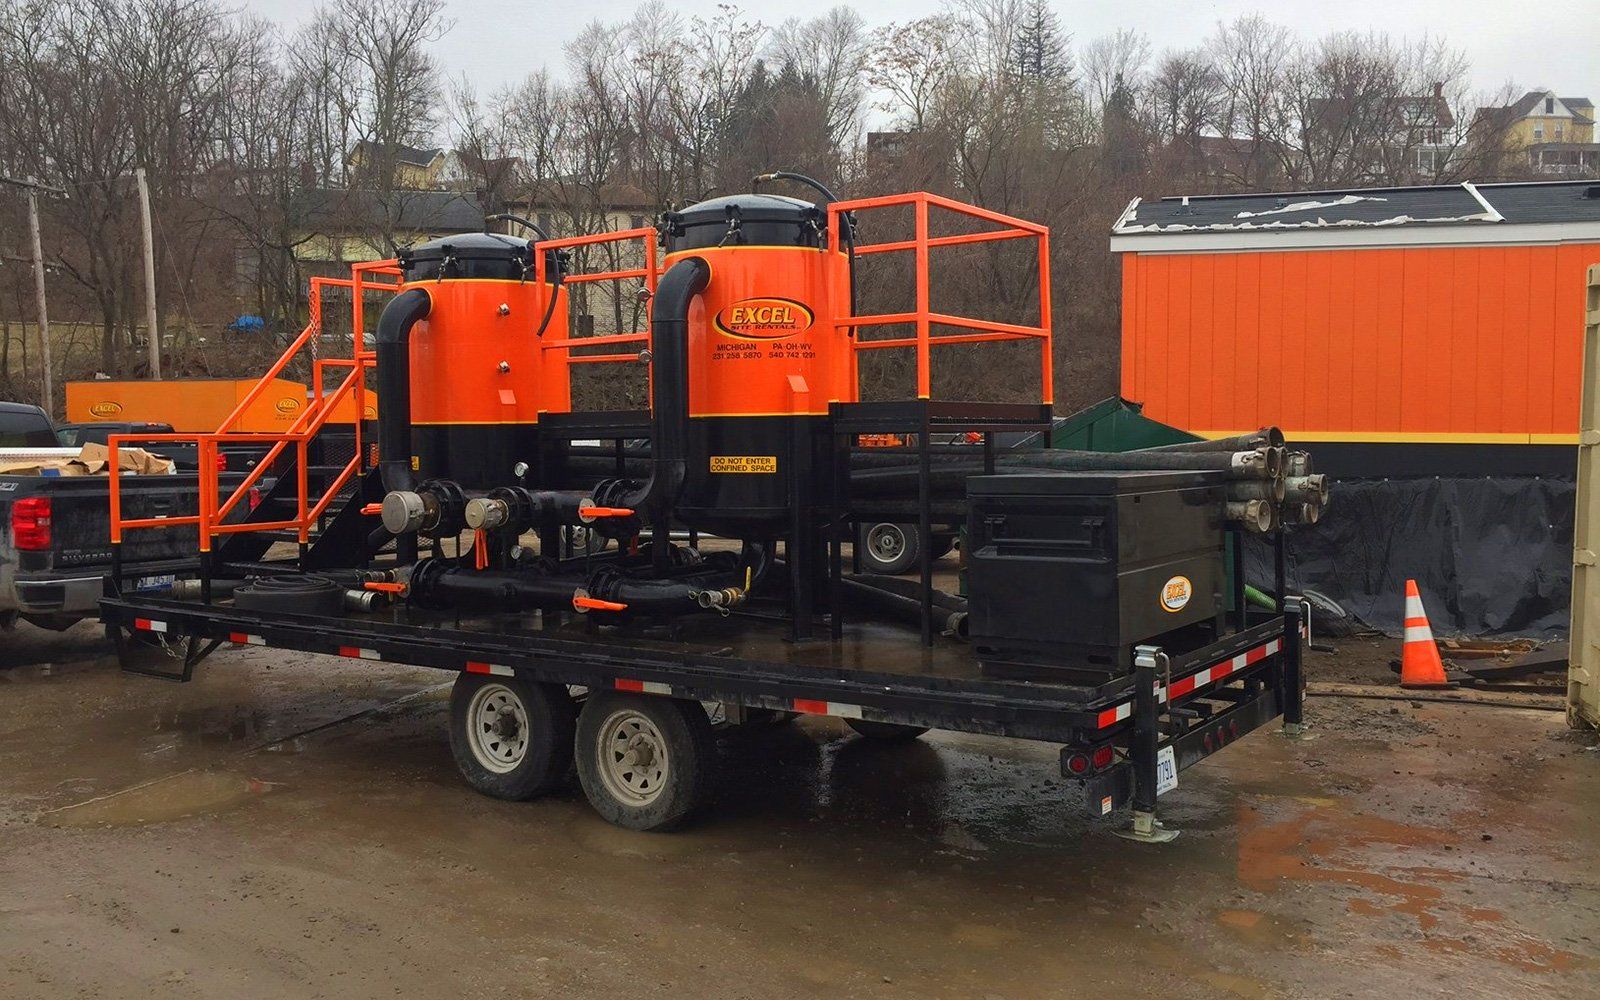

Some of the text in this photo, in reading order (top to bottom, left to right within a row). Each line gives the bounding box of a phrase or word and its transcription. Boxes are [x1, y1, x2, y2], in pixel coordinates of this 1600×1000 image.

[730, 306, 796, 324] EXCEL
[717, 343, 757, 351] MICHIGAN
[712, 352, 724, 360] 231
[1156, 759, 1173, 785] 7791
